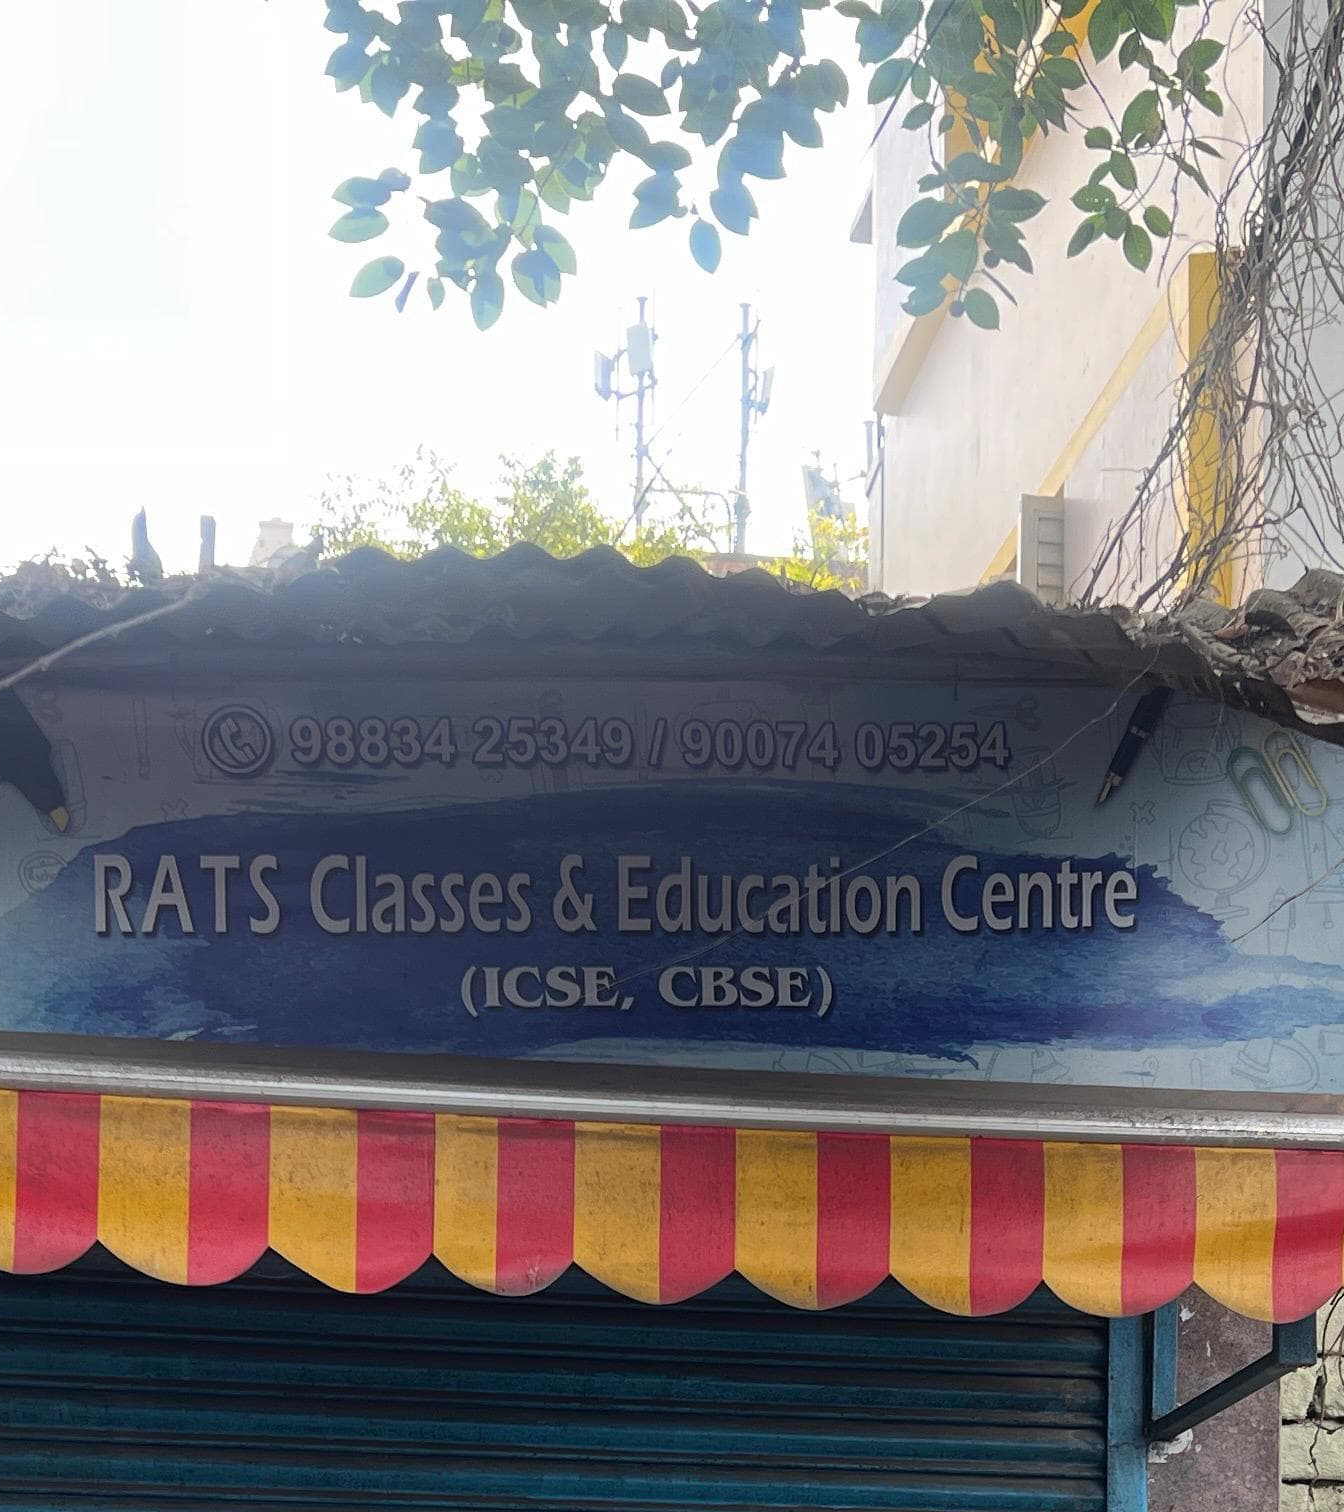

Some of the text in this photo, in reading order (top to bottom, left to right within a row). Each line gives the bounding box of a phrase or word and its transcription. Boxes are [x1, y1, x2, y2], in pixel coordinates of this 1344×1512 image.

[289, 717, 1010, 769] 98834 25349 / 90074 05254
[93, 853, 1138, 936] RATS Classes & Education Centre
[461, 965, 834, 1018] (ICSE, CBSE)
